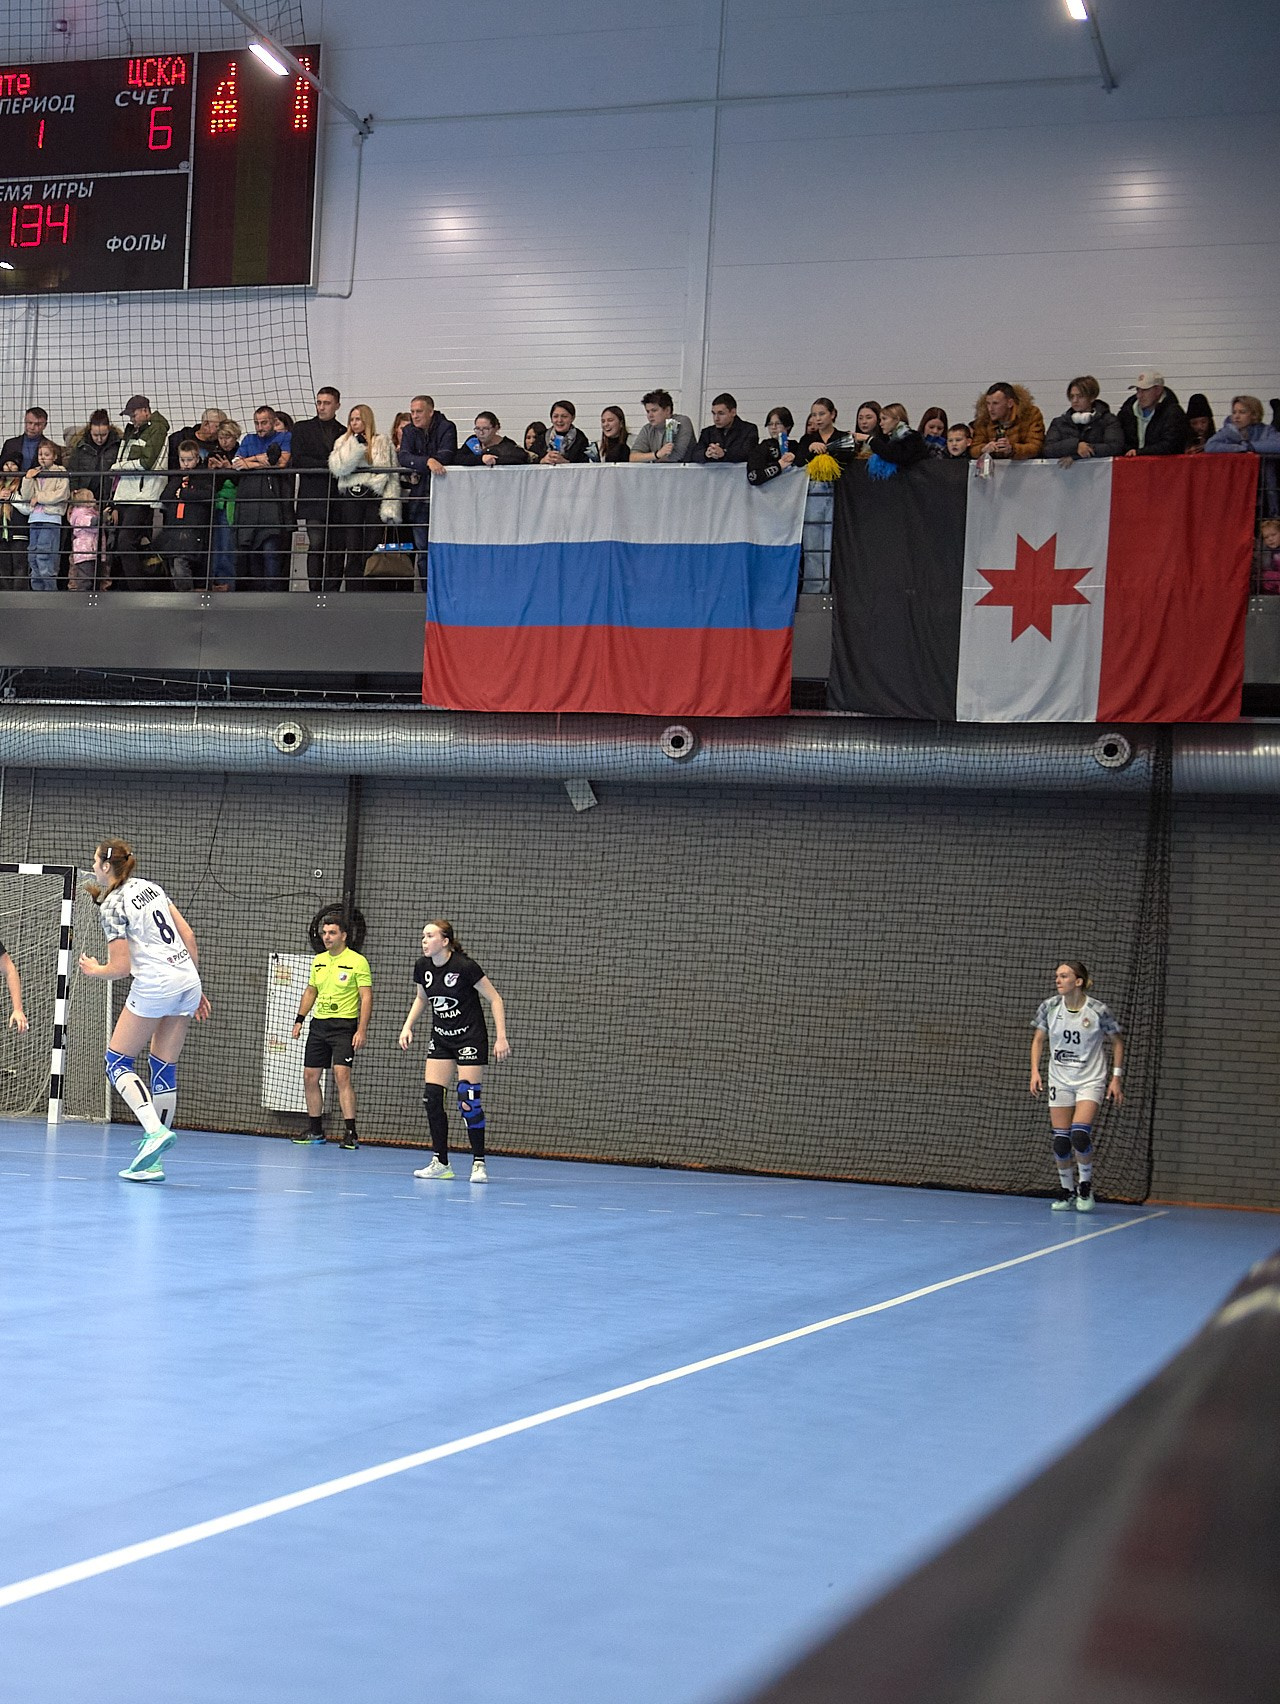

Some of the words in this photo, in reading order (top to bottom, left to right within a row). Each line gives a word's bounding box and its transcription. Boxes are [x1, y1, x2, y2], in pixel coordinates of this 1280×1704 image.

[127, 56, 187, 87] ЦСКА
[115, 87, 174, 107] СЧЕТ
[37, 119, 45, 149] 1
[148, 106, 173, 150] 6
[42, 181, 94, 201] ИГРЫ
[105, 233, 167, 253] ФОЛЫ
[152, 909, 175, 945] 8
[424, 970, 433, 989] 9
[1063, 1029, 1081, 1045] 93
